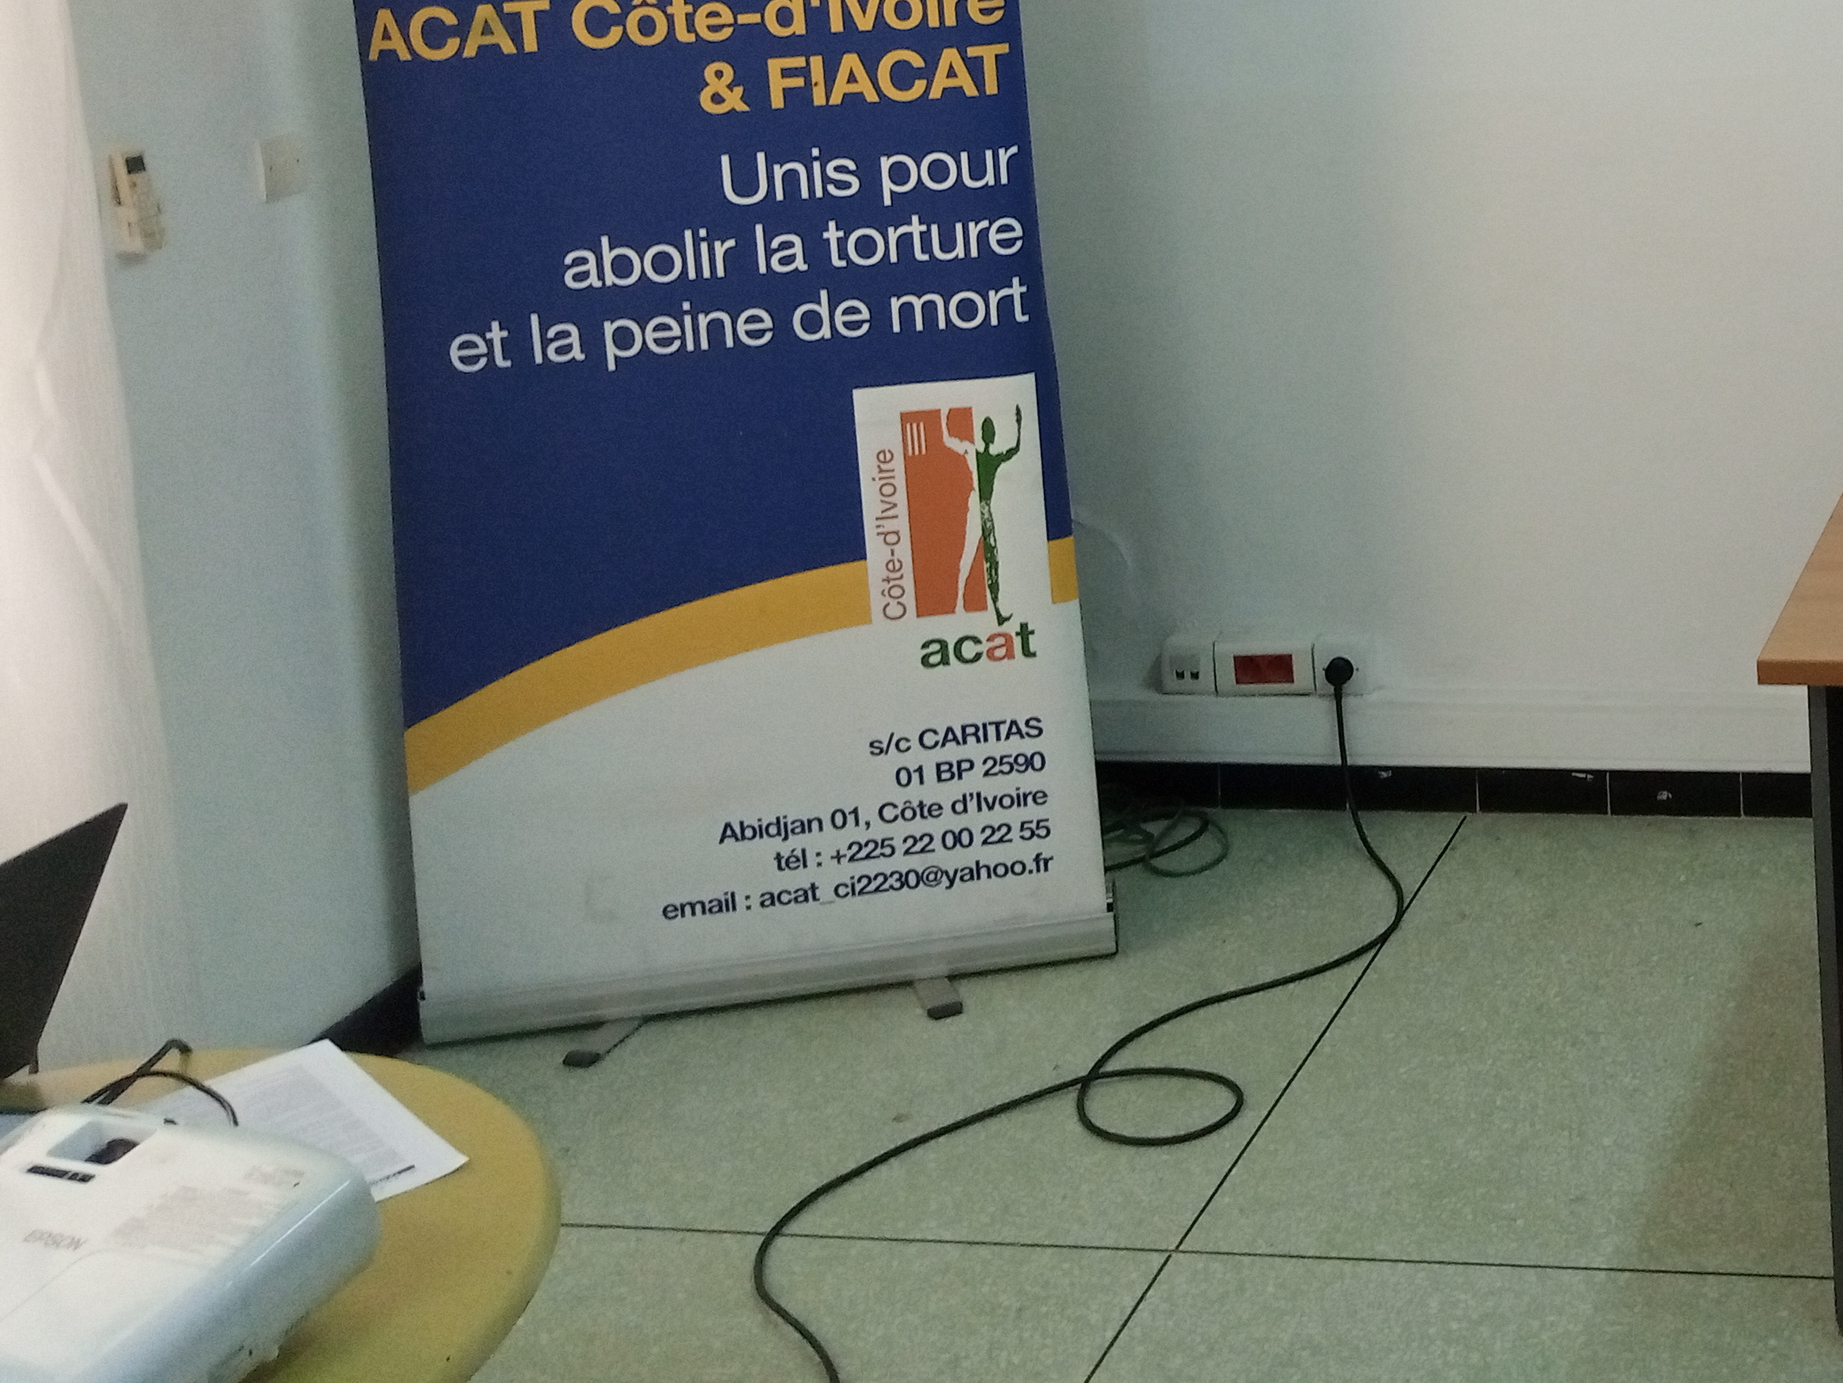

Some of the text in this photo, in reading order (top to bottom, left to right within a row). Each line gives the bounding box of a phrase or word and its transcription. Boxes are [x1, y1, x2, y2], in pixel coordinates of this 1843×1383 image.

[699, 42, 1010, 115] & FIACAT
[720, 143, 1019, 207] Unis pour
[562, 213, 1025, 291] abolir la torture
[448, 276, 1030, 374] et la peine de mort
[870, 447, 907, 621] Côte-d'Ivoire
[919, 621, 1037, 670] acat
[868, 716, 1045, 757] s/c CARITAS
[894, 750, 1047, 788] 01 BP 2590
[718, 786, 1049, 846] Abidjan 01, Côte d'Ivoire
[773, 847, 809, 874] tél
[830, 837, 896, 867] +225
[902, 832, 936, 858] 22
[940, 826, 974, 852] 00
[979, 822, 1014, 847] 22
[1018, 817, 1052, 842] 55
[661, 891, 738, 921] email
[759, 852, 1055, 909] acat_ci2230@yahoo.fr
[22, 1228, 88, 1252] EPSON
